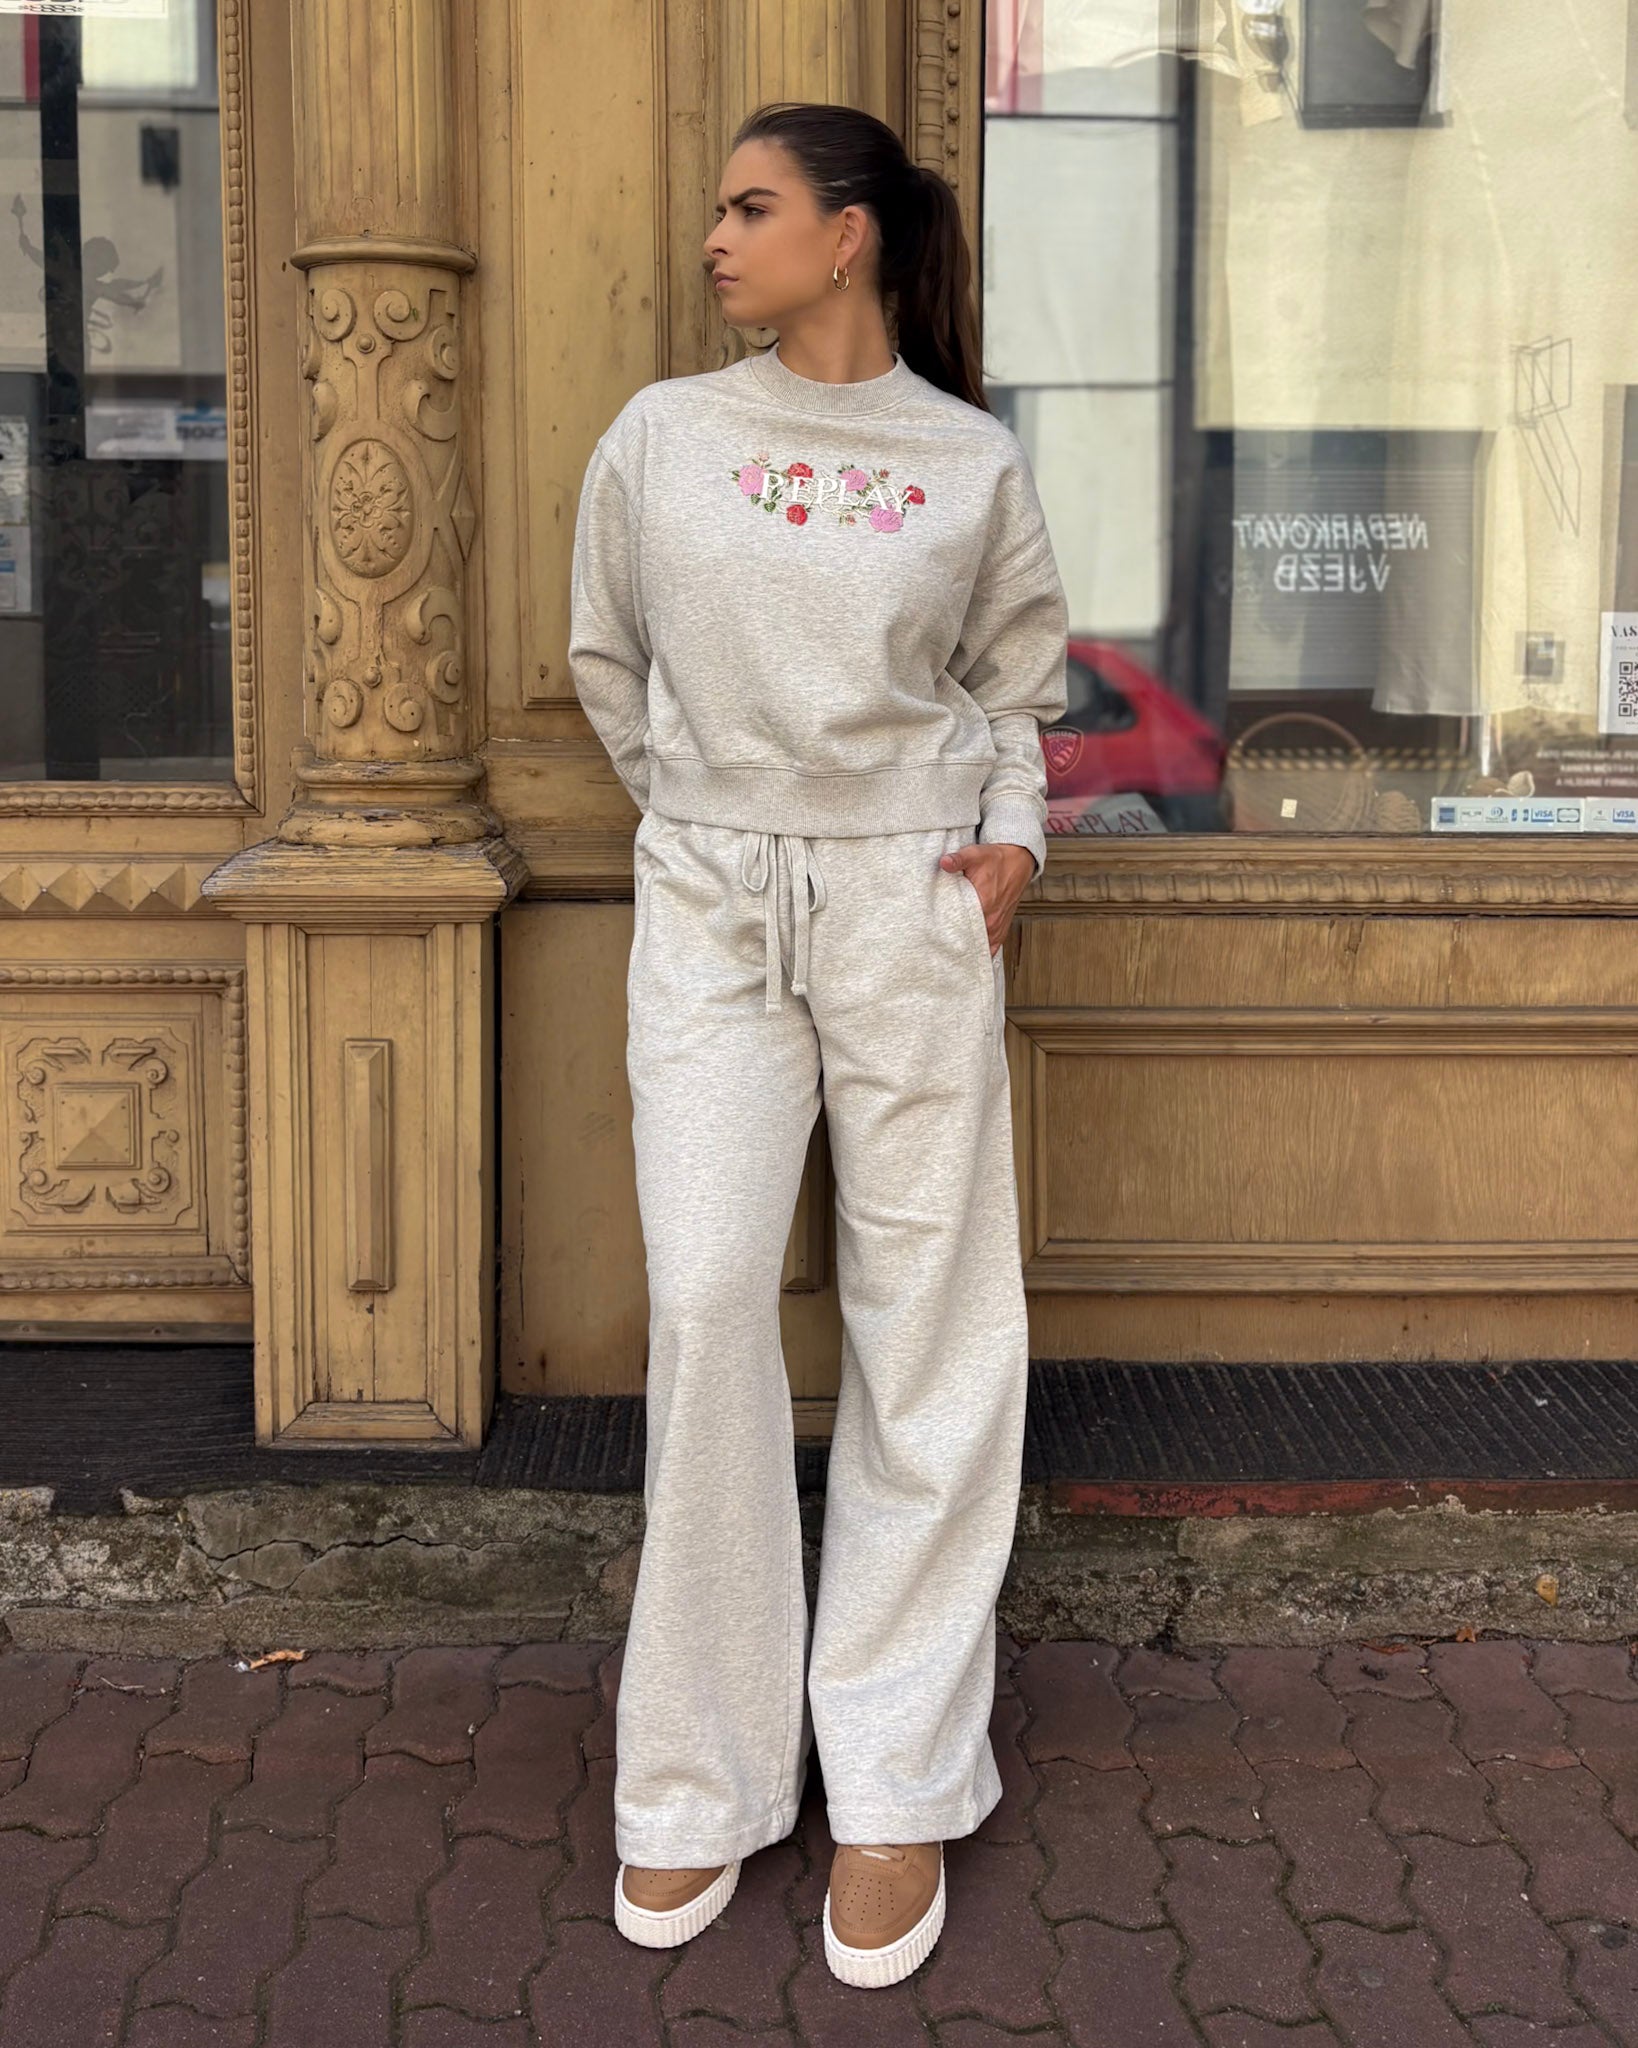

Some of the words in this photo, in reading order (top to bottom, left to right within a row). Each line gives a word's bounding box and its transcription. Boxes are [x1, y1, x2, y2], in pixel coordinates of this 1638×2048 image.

[760, 472, 912, 515] REPLAY
[1534, 809, 1554, 818] VISA
[1616, 809, 1635, 818] VISA
